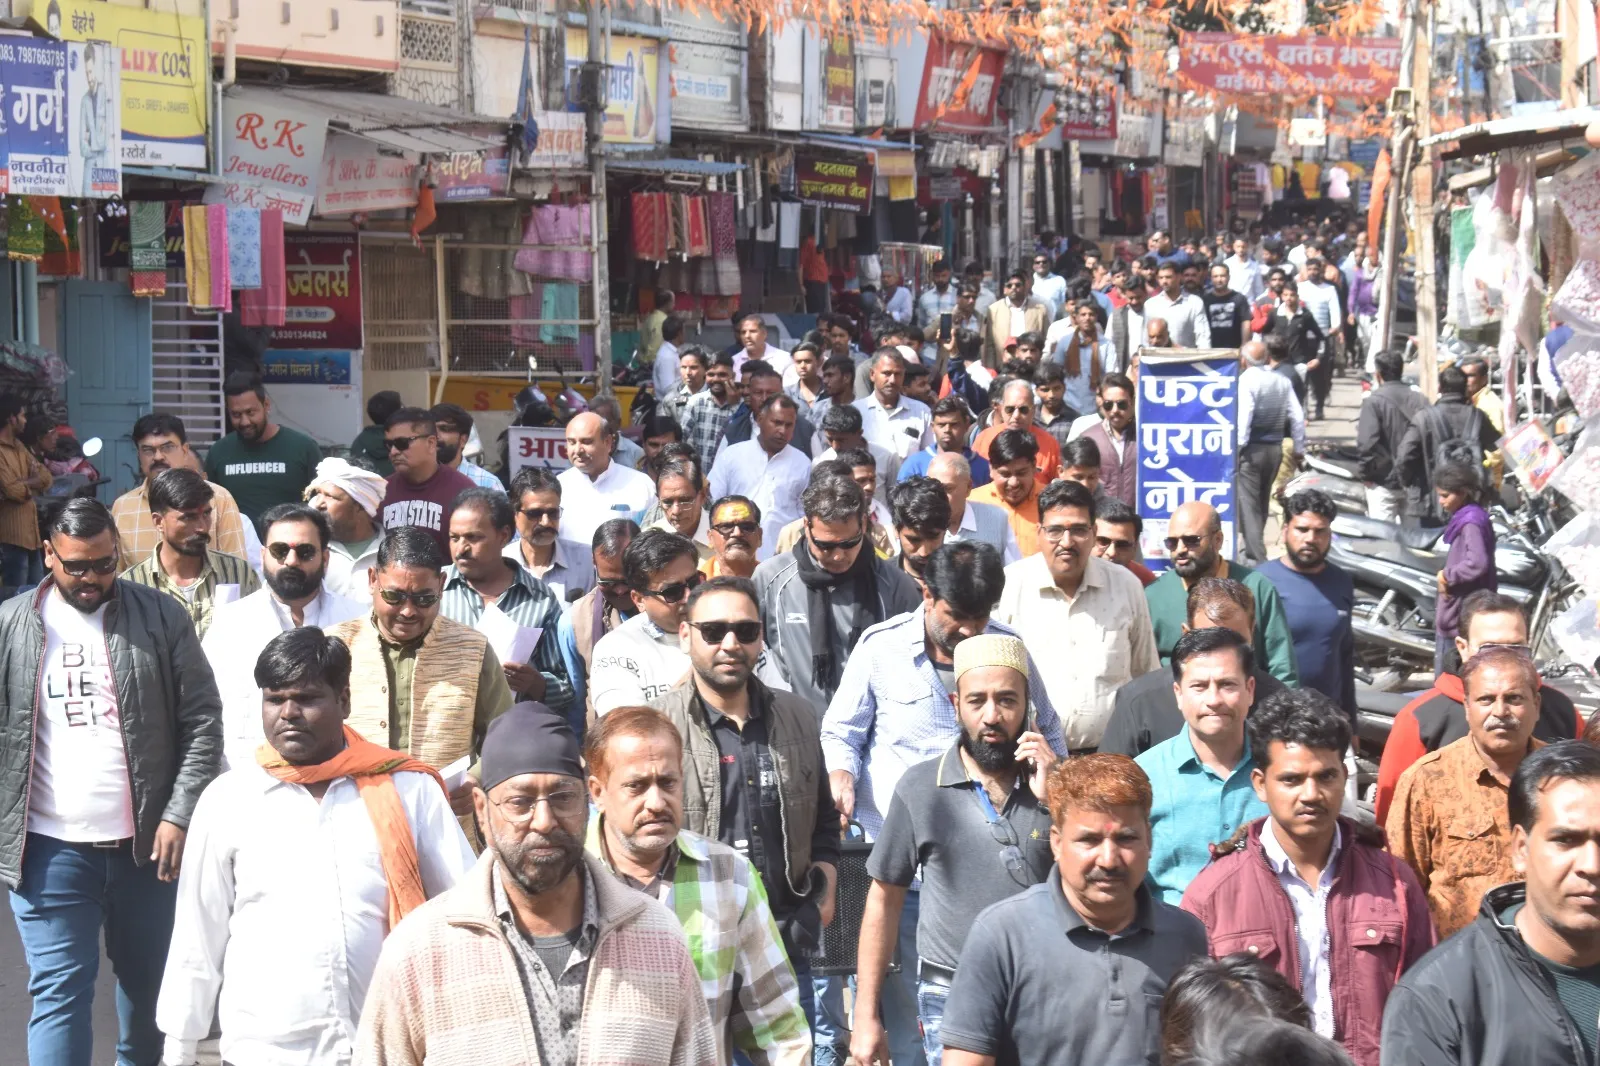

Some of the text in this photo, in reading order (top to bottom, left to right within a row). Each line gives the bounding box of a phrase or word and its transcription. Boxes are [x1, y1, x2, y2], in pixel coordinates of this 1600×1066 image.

[1340, 45, 1401, 68] भण्डा
[11, 157, 66, 174] नवनीत
[224, 155, 308, 187] Jewellers
[1141, 363, 1235, 408] फटे
[1141, 409, 1234, 469] पुराने
[225, 462, 286, 476] INFLUENCER
[1143, 467, 1231, 514] नोट
[383, 499, 443, 532] PENN STATE
